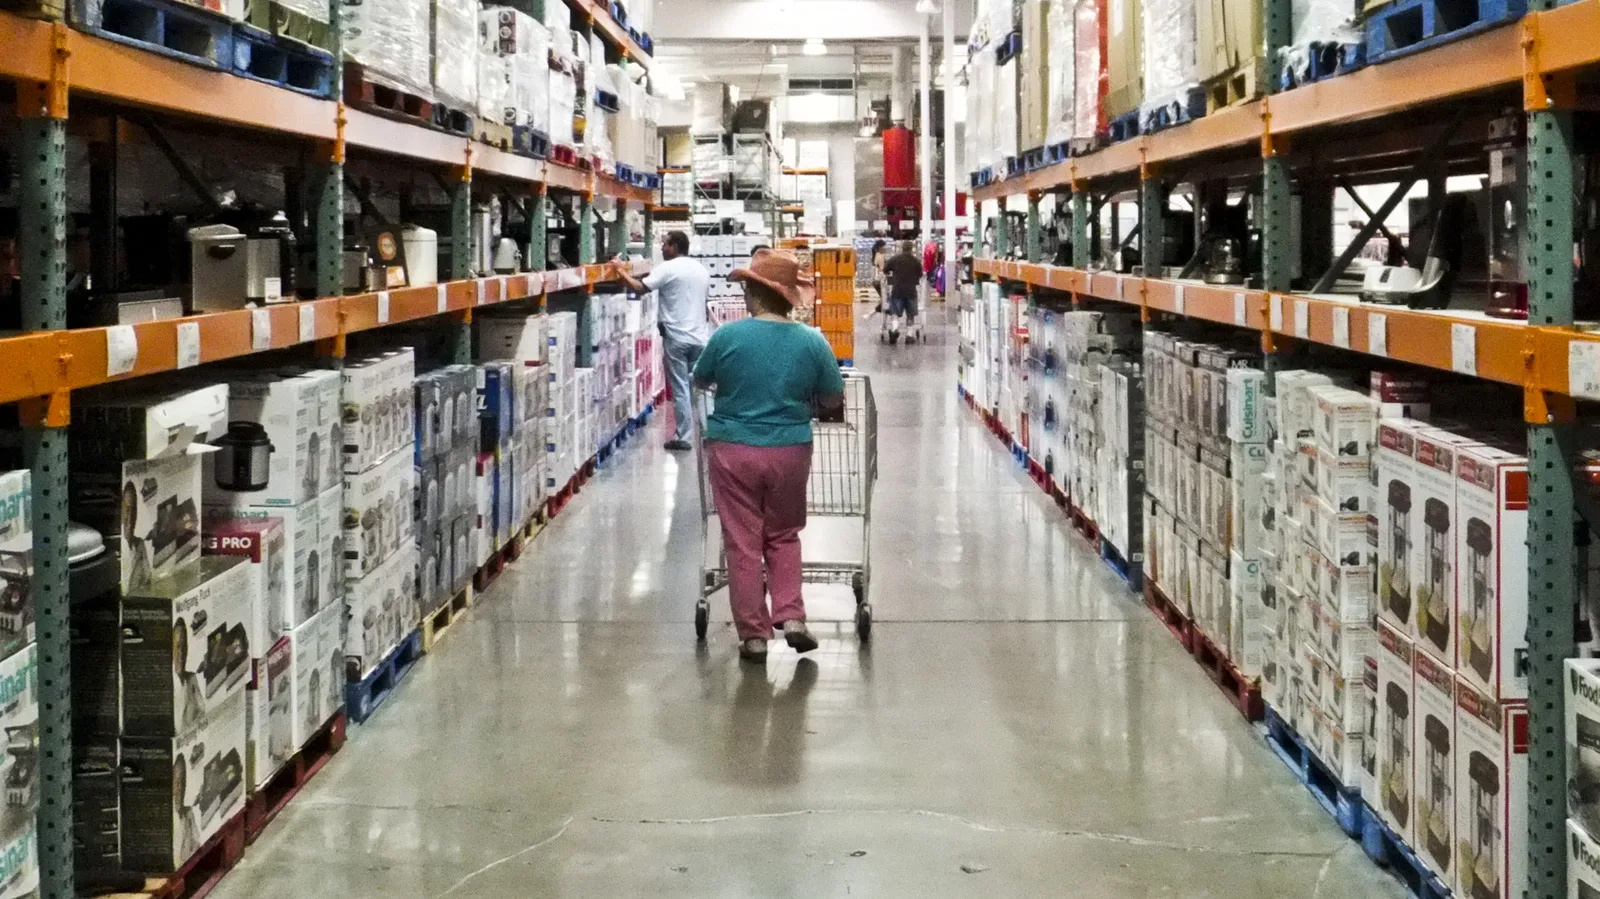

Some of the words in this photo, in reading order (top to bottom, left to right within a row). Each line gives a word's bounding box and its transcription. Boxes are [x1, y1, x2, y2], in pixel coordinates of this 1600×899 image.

[1231, 359, 1249, 369] MR
[1242, 378, 1254, 439] Cuisinart
[222, 536, 252, 549] PRO
